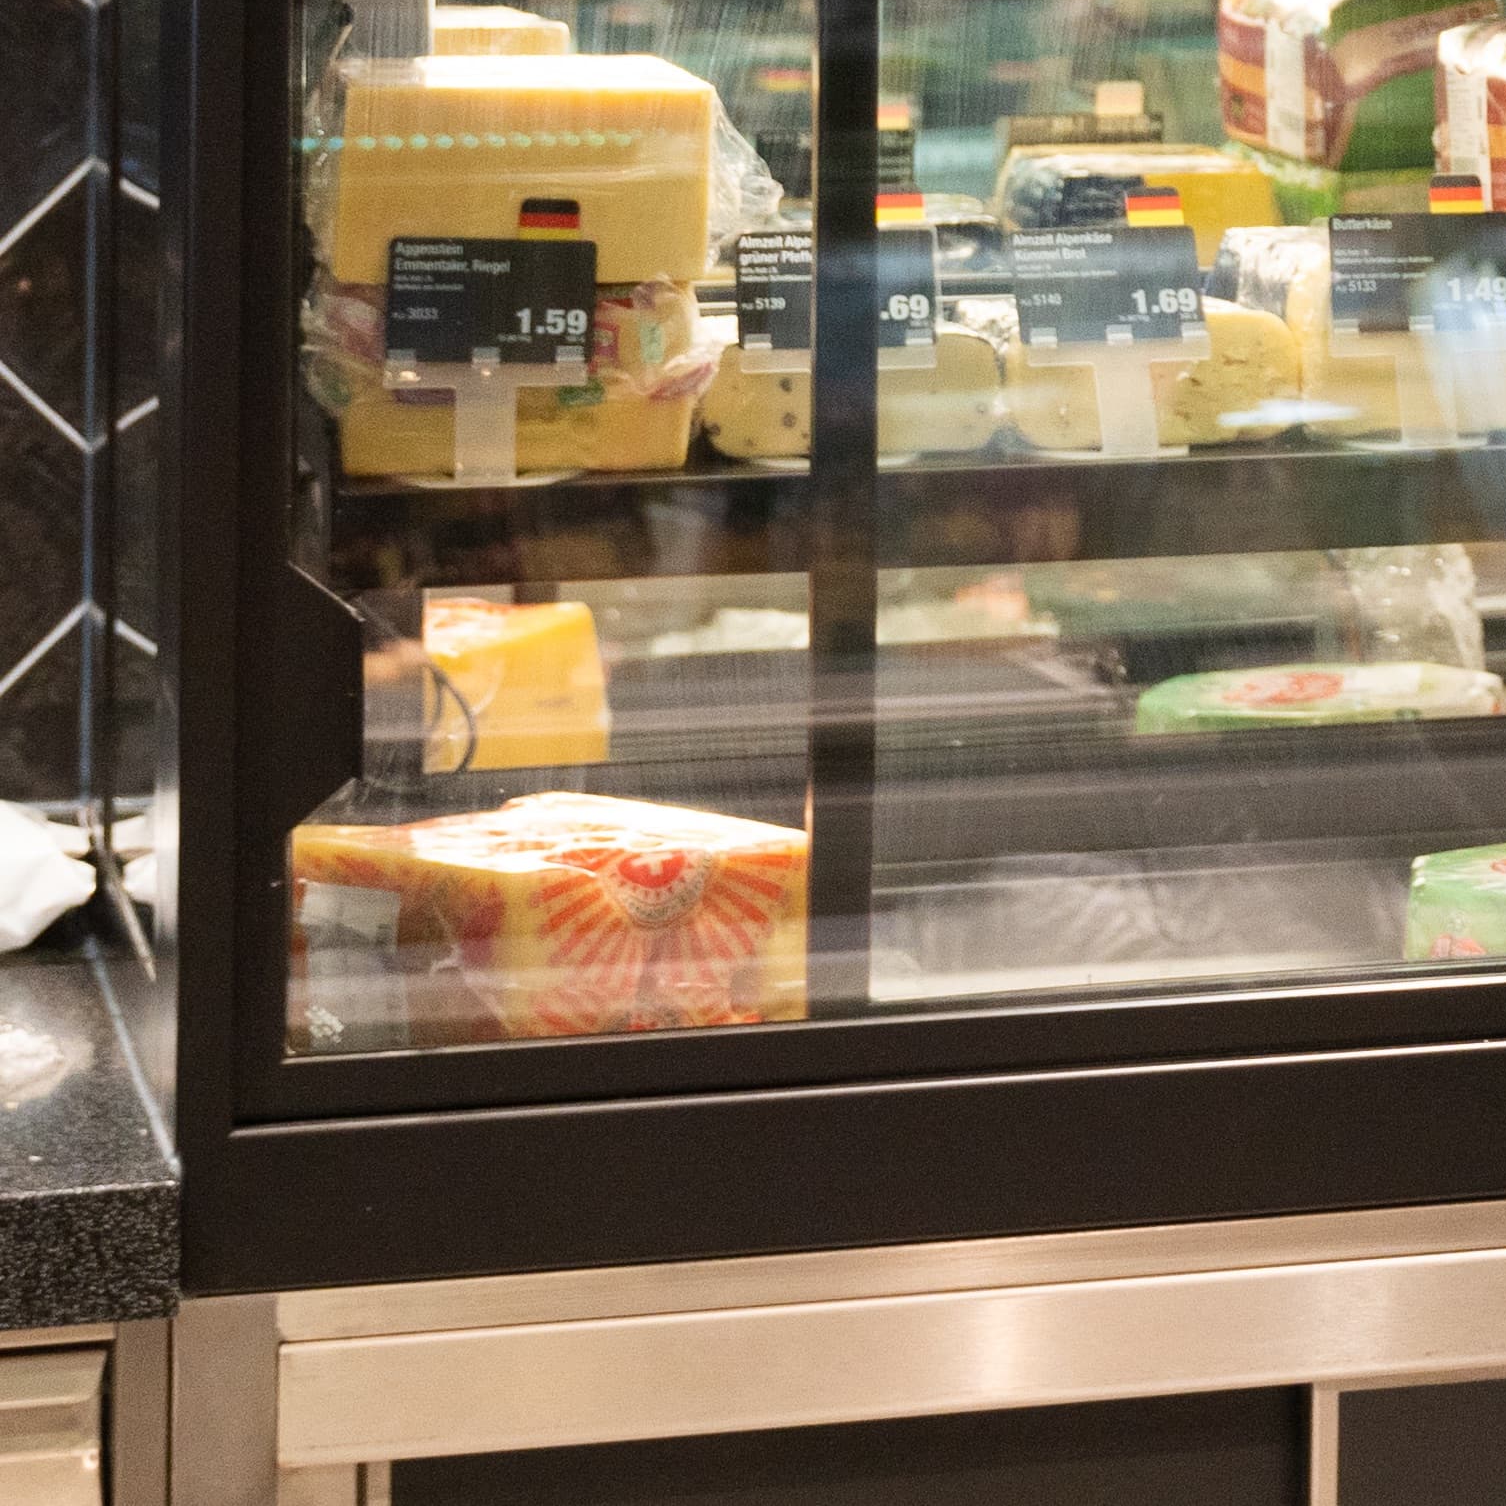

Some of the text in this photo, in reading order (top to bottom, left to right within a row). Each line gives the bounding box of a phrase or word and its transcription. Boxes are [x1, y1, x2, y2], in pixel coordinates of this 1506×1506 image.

[1332, 217, 1394, 232] Butterkäse
[738, 235, 784, 249] Almzeit
[1012, 231, 1114, 247] Almzeit Alpenkäse
[394, 242, 465, 257] Aggenstein
[471, 258, 512, 276] Riegel
[738, 251, 779, 267] grüner
[878, 294, 931, 322] .69
[1130, 287, 1199, 315] 1.69
[515, 307, 590, 336] 1.59
